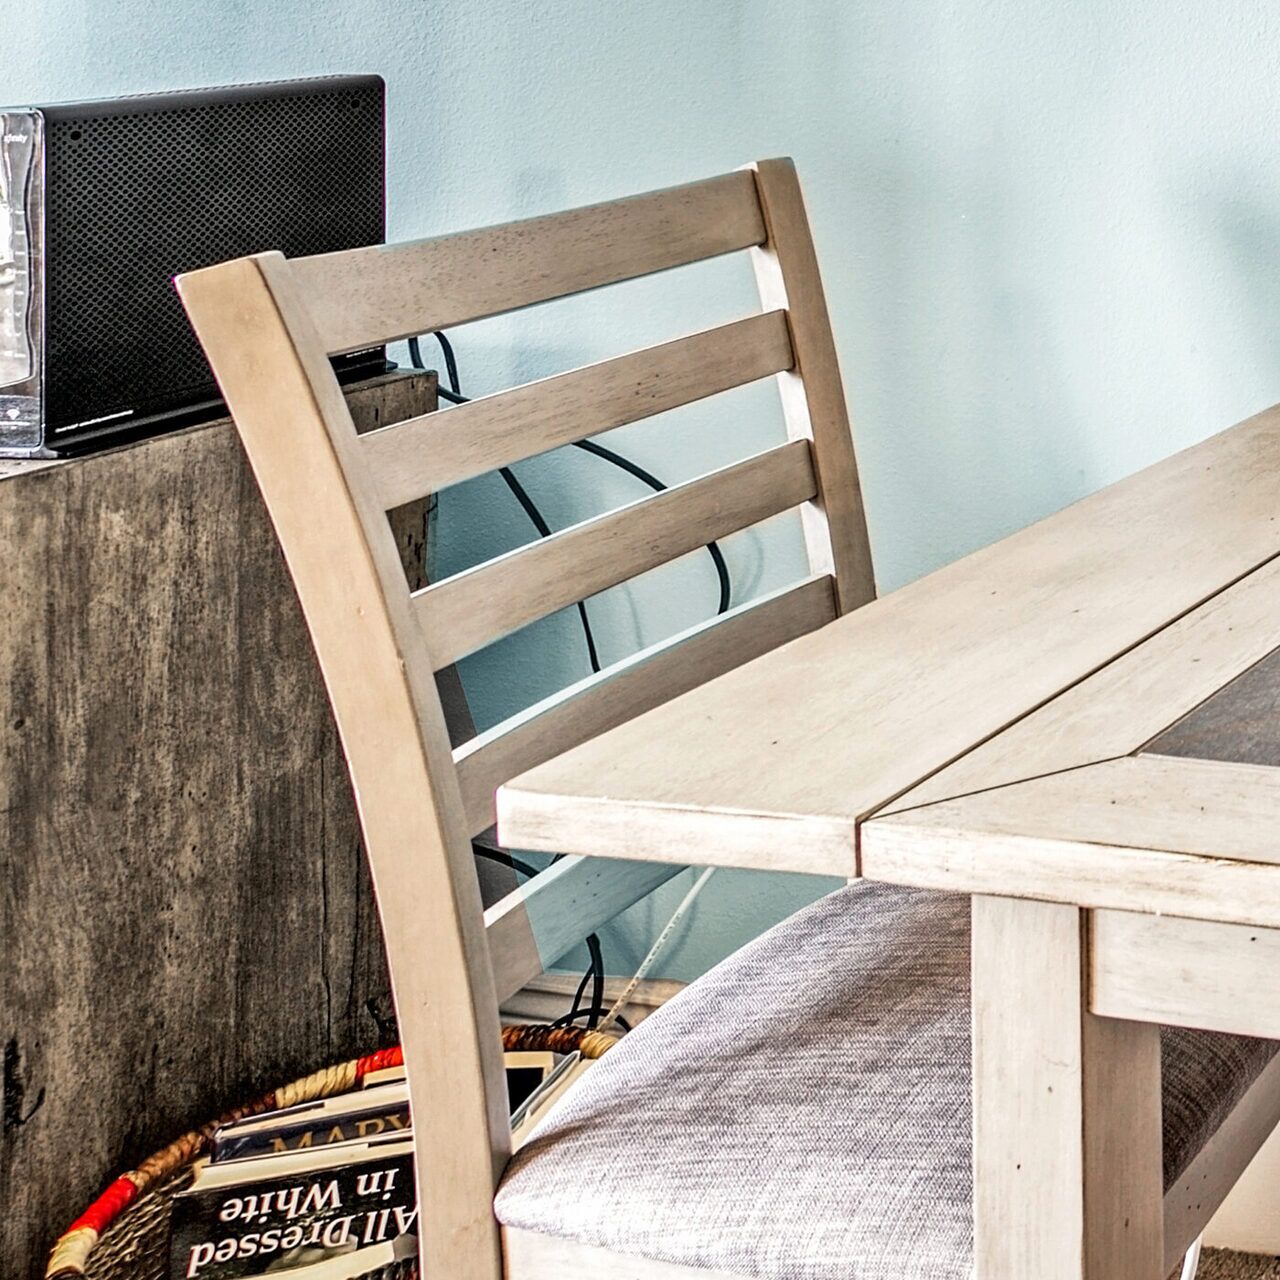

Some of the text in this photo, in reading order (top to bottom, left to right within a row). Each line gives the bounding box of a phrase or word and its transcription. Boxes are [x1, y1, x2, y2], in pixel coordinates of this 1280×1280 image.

[219, 1168, 400, 1224] in White
[186, 1205, 419, 1279] All Dressed
